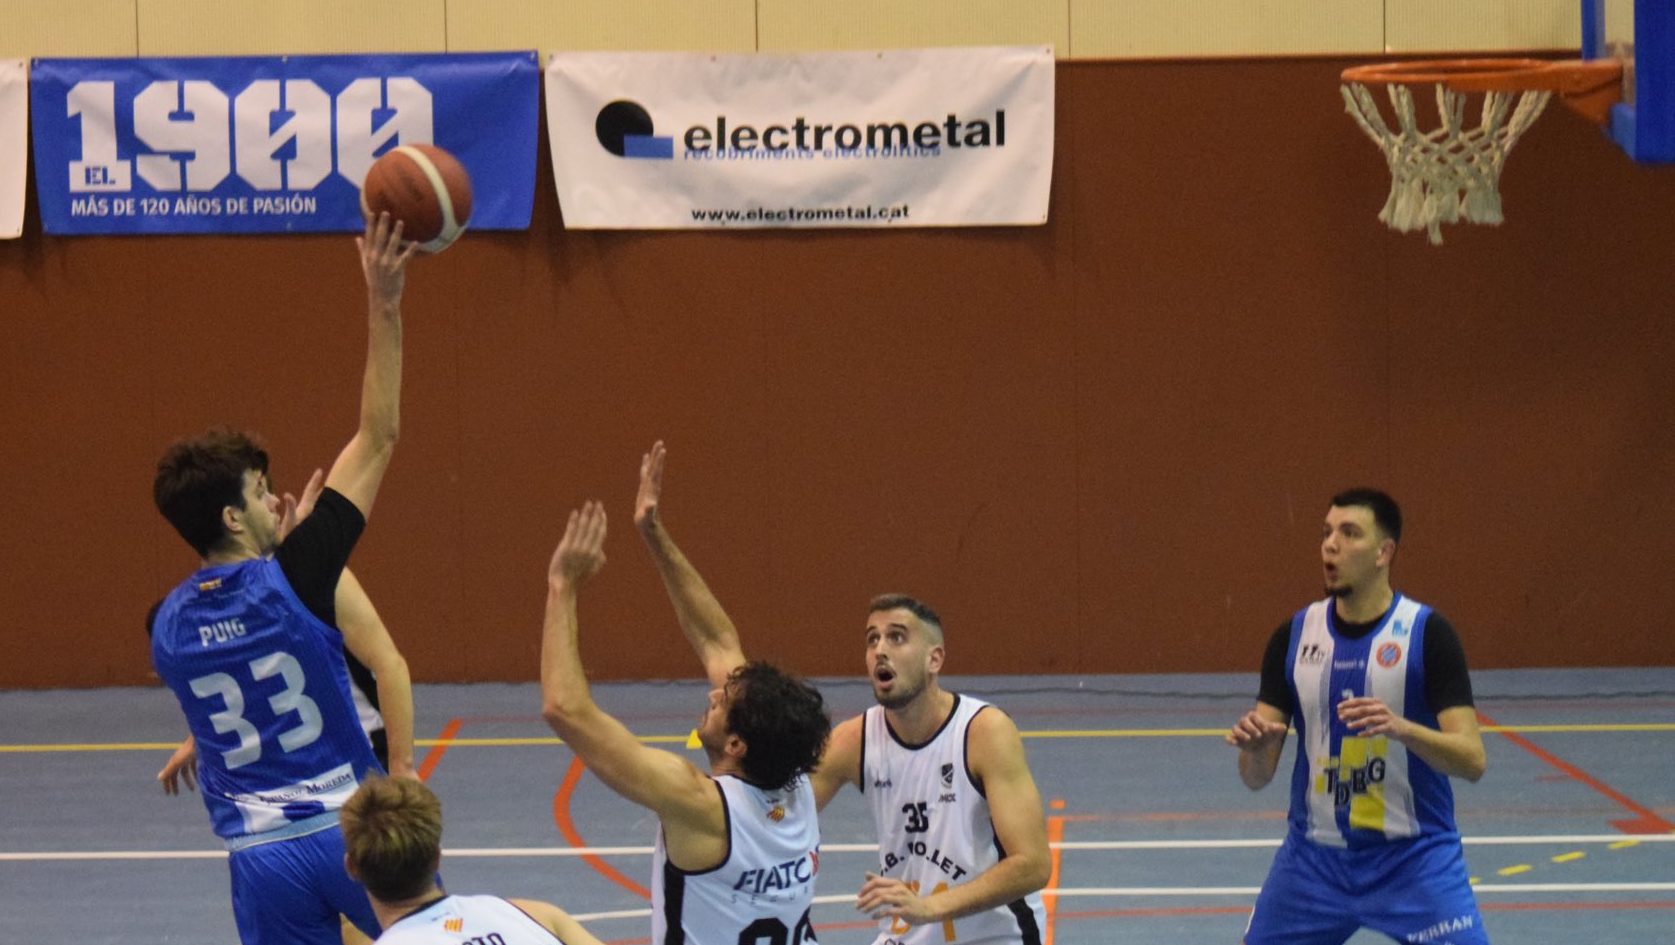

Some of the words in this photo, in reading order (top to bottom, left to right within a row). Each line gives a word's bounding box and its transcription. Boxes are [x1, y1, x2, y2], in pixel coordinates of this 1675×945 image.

[67, 77, 434, 192] 1900
[684, 109, 1006, 153] electrometal
[70, 194, 109, 217] MÁS
[113, 197, 136, 216] DE
[140, 198, 170, 216] 120
[174, 195, 222, 216] AÑOS
[226, 197, 249, 215] DE
[253, 192, 317, 215] PASIÓN
[691, 204, 910, 222] www.electrometal.cat
[199, 617, 247, 647] PUIG
[188, 651, 324, 770] 33
[902, 802, 929, 833] 35
